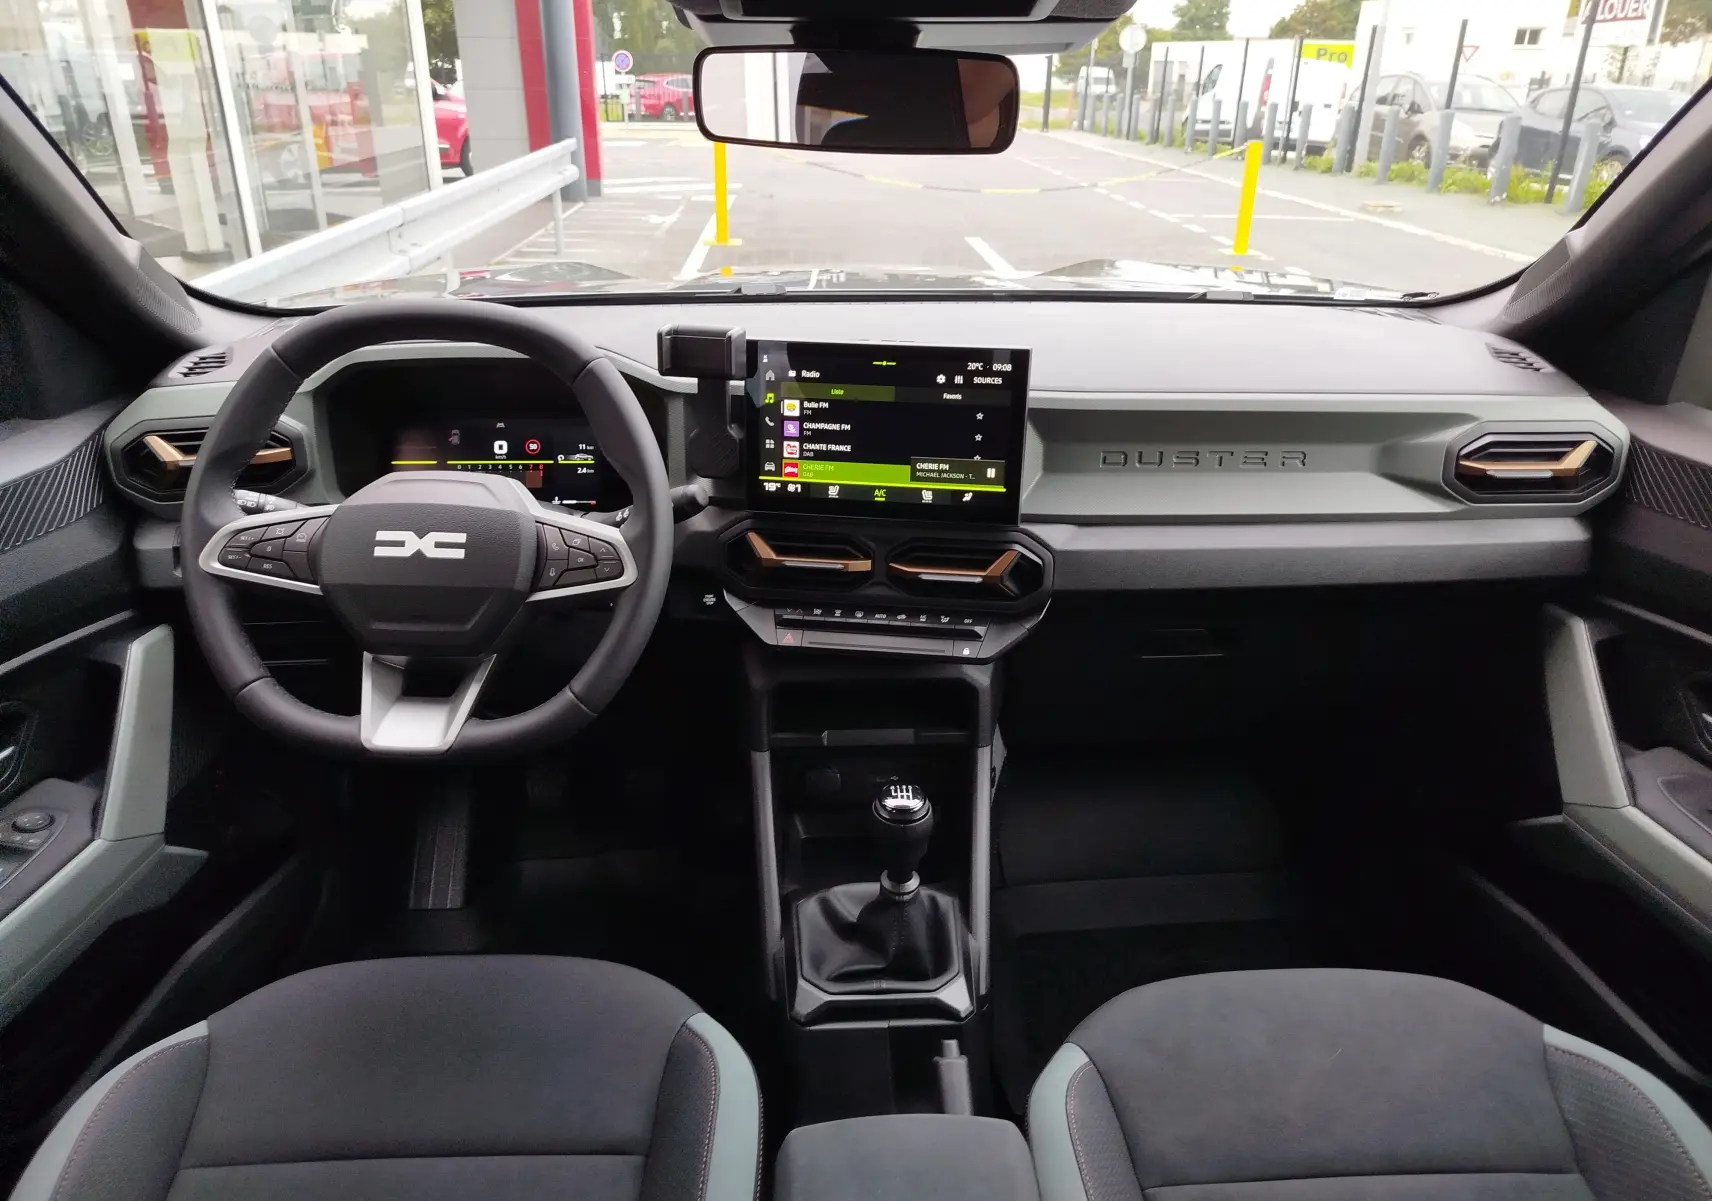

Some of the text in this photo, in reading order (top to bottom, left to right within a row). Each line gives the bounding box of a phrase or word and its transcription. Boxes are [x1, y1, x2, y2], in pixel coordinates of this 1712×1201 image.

[1316, 48, 1347, 63] Pro
[992, 363, 1012, 371] 09:08
[801, 370, 820, 378] Radio
[973, 376, 1002, 385] SOURCES
[943, 392, 962, 400] Favoris
[803, 401, 818, 409] Bulle
[803, 422, 851, 431] CHAMPAGNE FM
[803, 443, 827, 451] CHANTE
[828, 444, 851, 452] FRANCE
[1099, 450, 1307, 468] DUSTER
[941, 471, 965, 479] JACKSON
[874, 489, 886, 497] A/C
